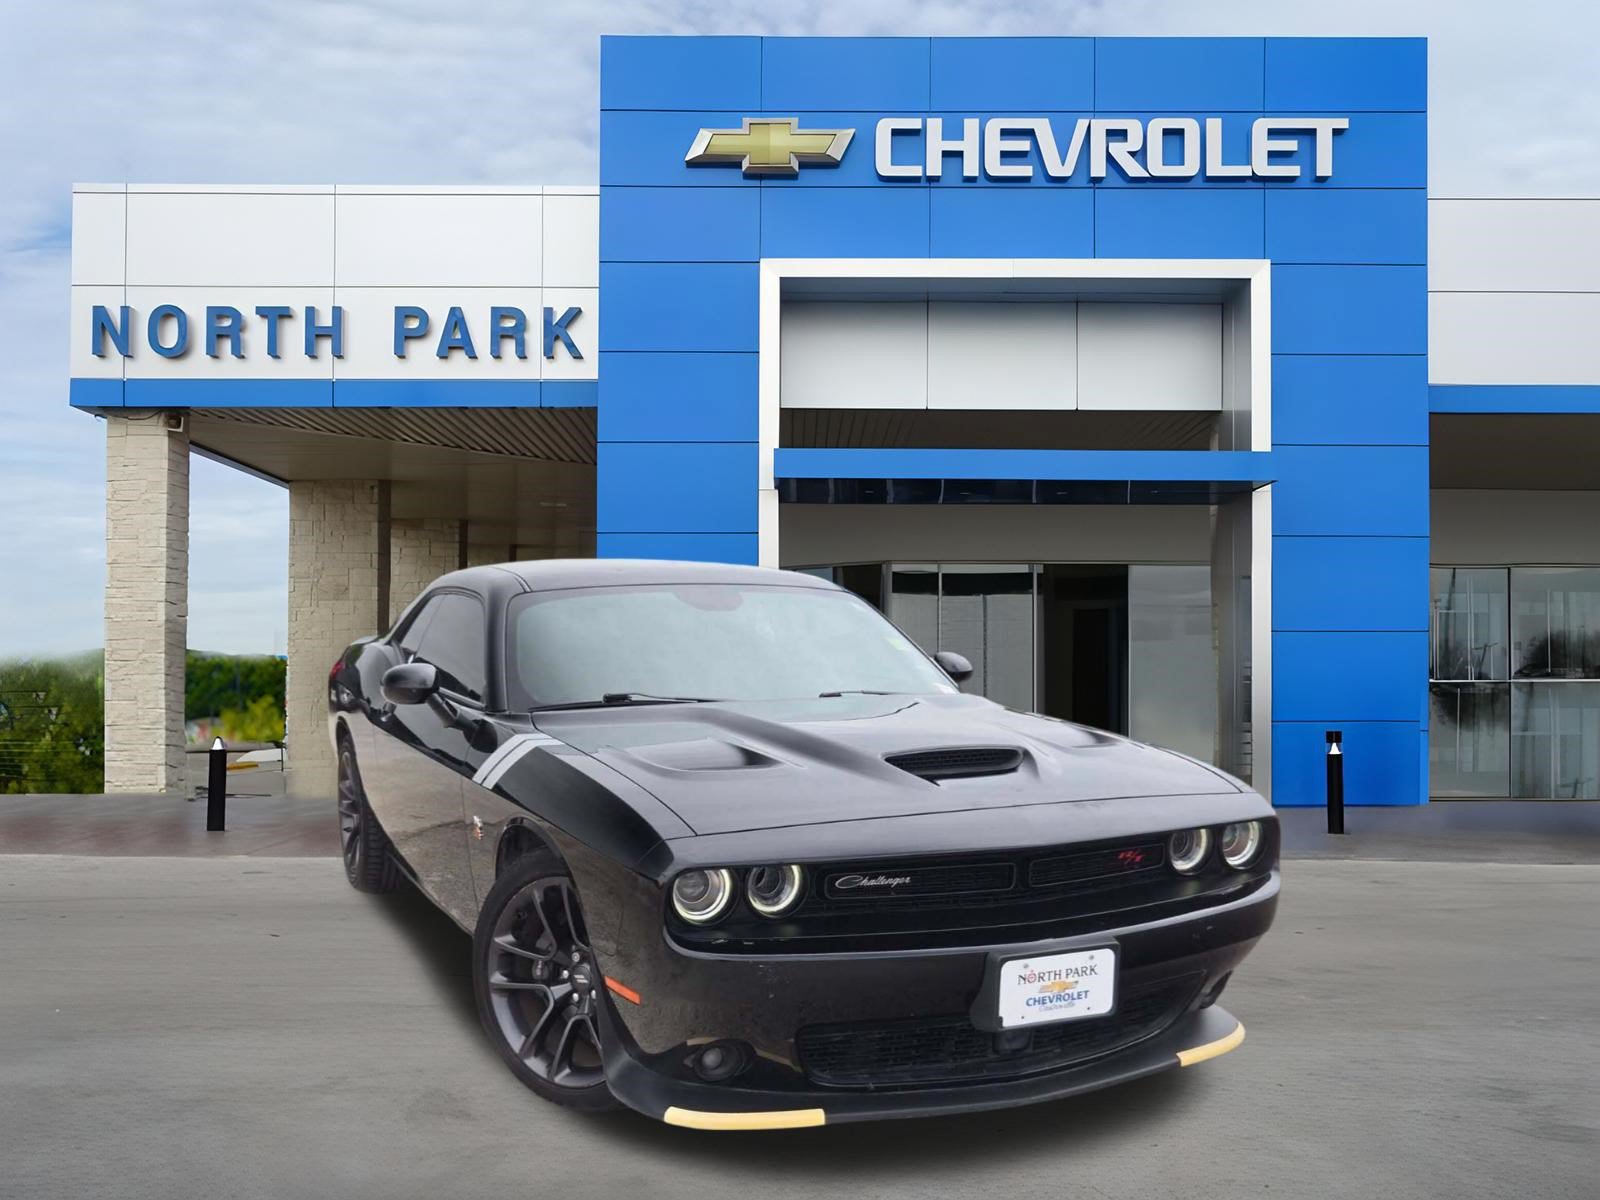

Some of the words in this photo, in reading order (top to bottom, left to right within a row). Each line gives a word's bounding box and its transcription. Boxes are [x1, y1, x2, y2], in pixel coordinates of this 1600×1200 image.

[875, 117, 1350, 180] CHEVROLET
[91, 303, 345, 360] NORTH
[394, 305, 585, 360] PARK
[834, 874, 912, 889] Challenger
[1017, 969, 1062, 985] NORTH
[1065, 964, 1099, 979] PARK
[1025, 990, 1090, 1007] CHEVROLET
